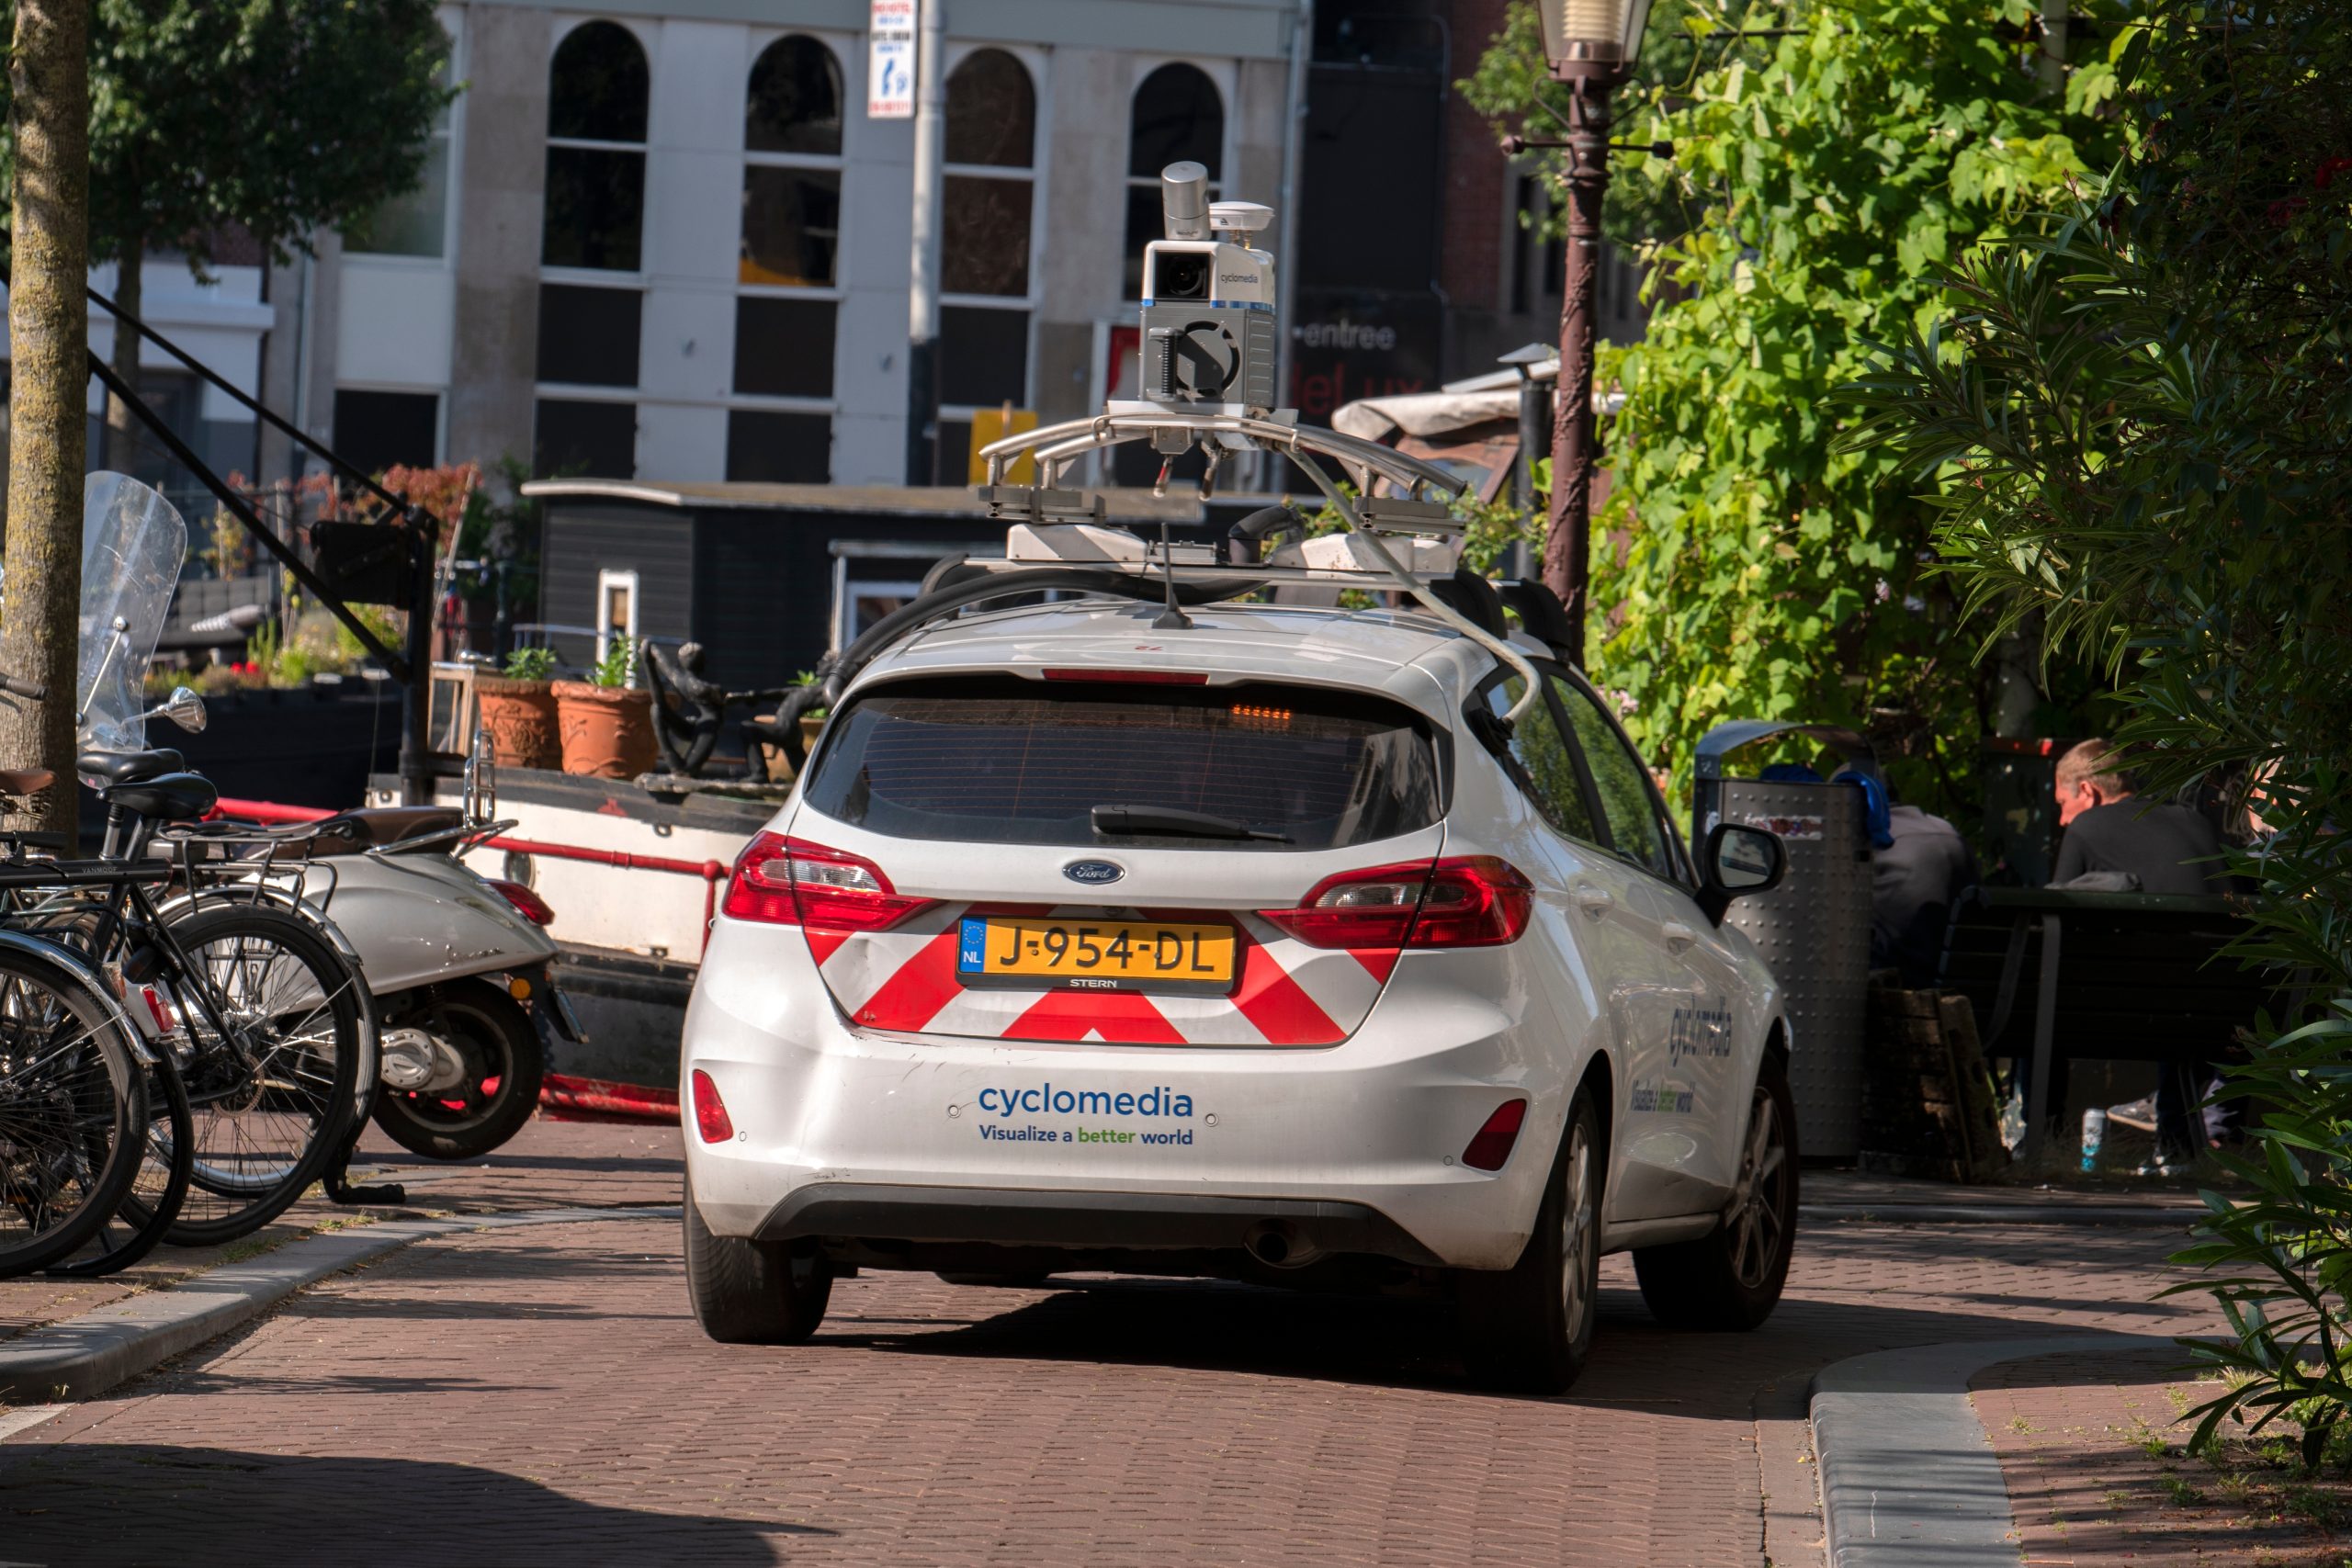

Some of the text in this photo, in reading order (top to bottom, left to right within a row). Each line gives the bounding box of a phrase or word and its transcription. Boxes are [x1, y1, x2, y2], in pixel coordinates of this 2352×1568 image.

[1220, 274, 1259, 284] cyclomedia
[82, 866, 118, 874] VANMOOF
[1076, 864, 1111, 878] Ford
[999, 926, 1215, 973] J-954-DL
[963, 950, 981, 964] NL
[1069, 978, 1117, 988] STERN
[978, 1082, 1193, 1118] cyclomedia
[979, 1124, 1193, 1145] Visualize a better world
